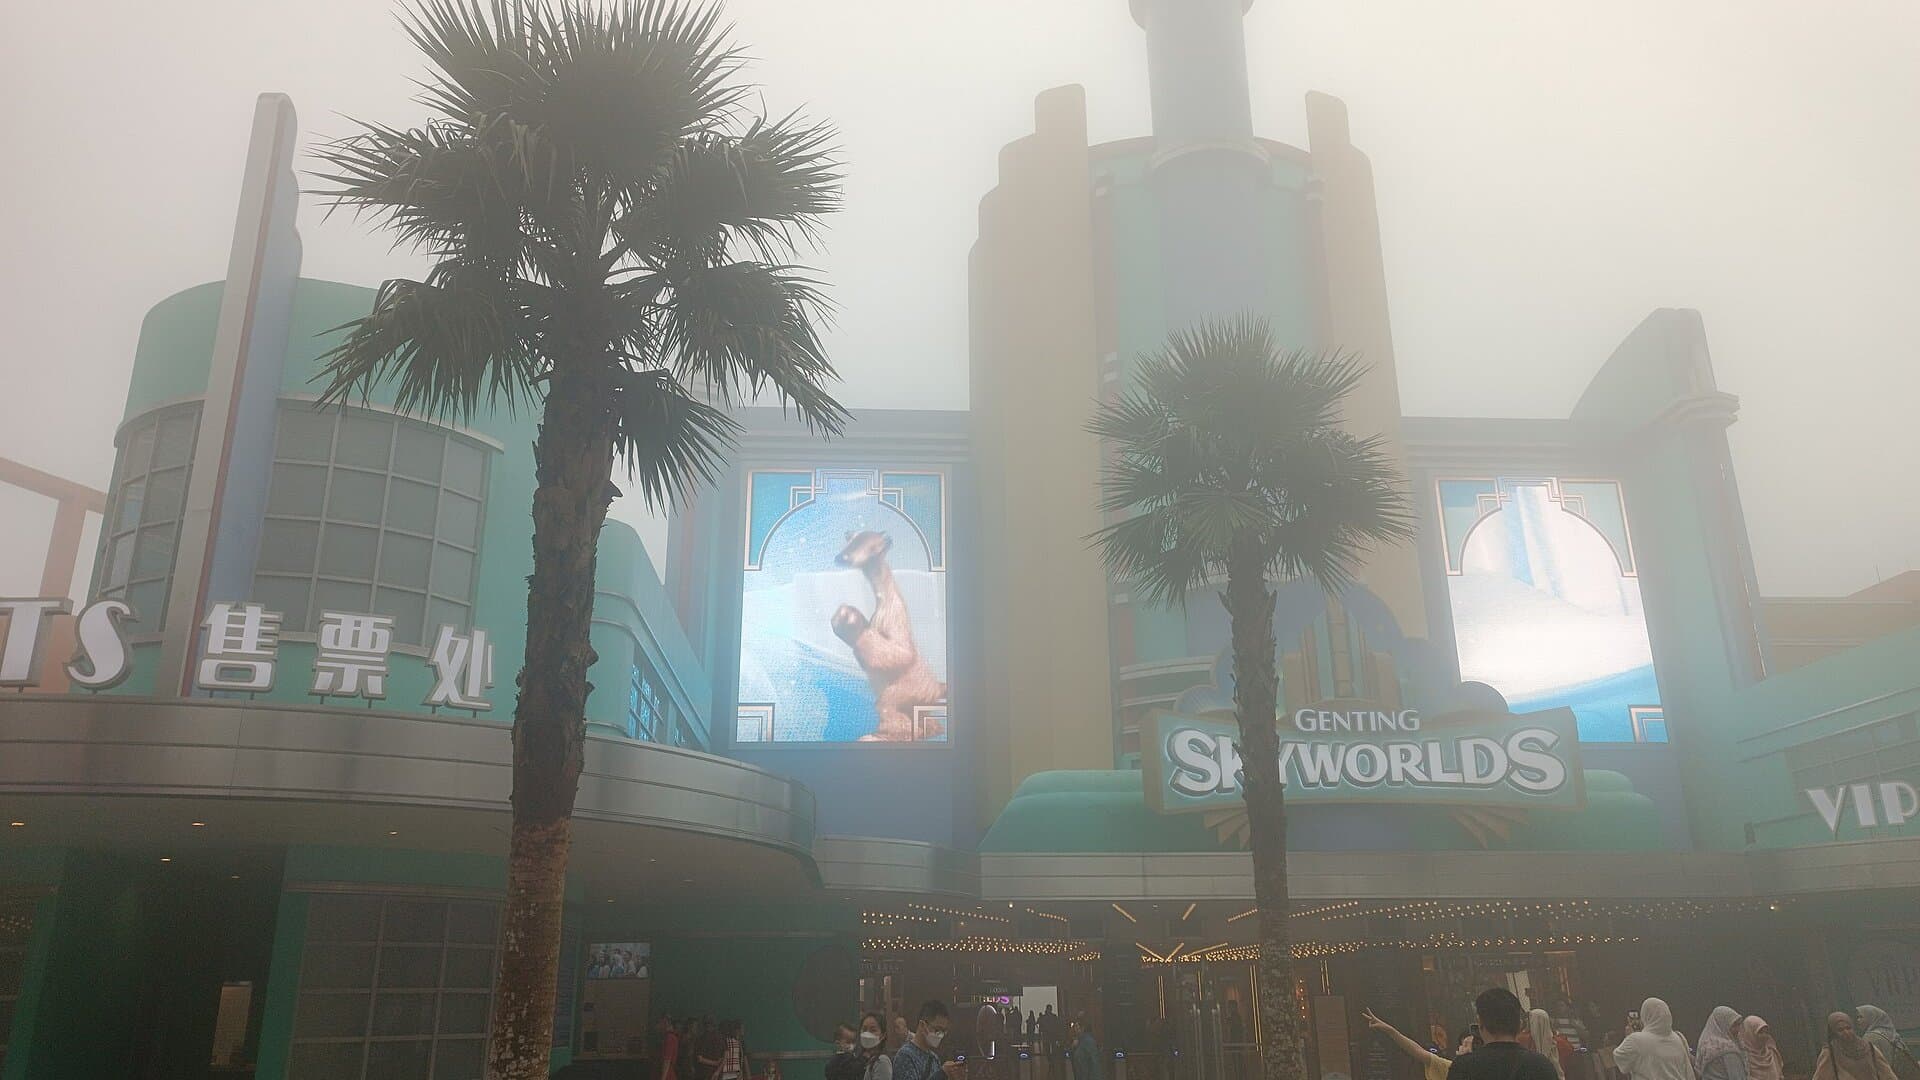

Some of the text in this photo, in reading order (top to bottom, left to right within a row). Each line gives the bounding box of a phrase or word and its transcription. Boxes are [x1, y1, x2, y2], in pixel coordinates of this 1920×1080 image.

[198, 601, 495, 711] 售票处
[1294, 708, 1421, 732] GENTING
[1805, 780, 1920, 832] VIP
